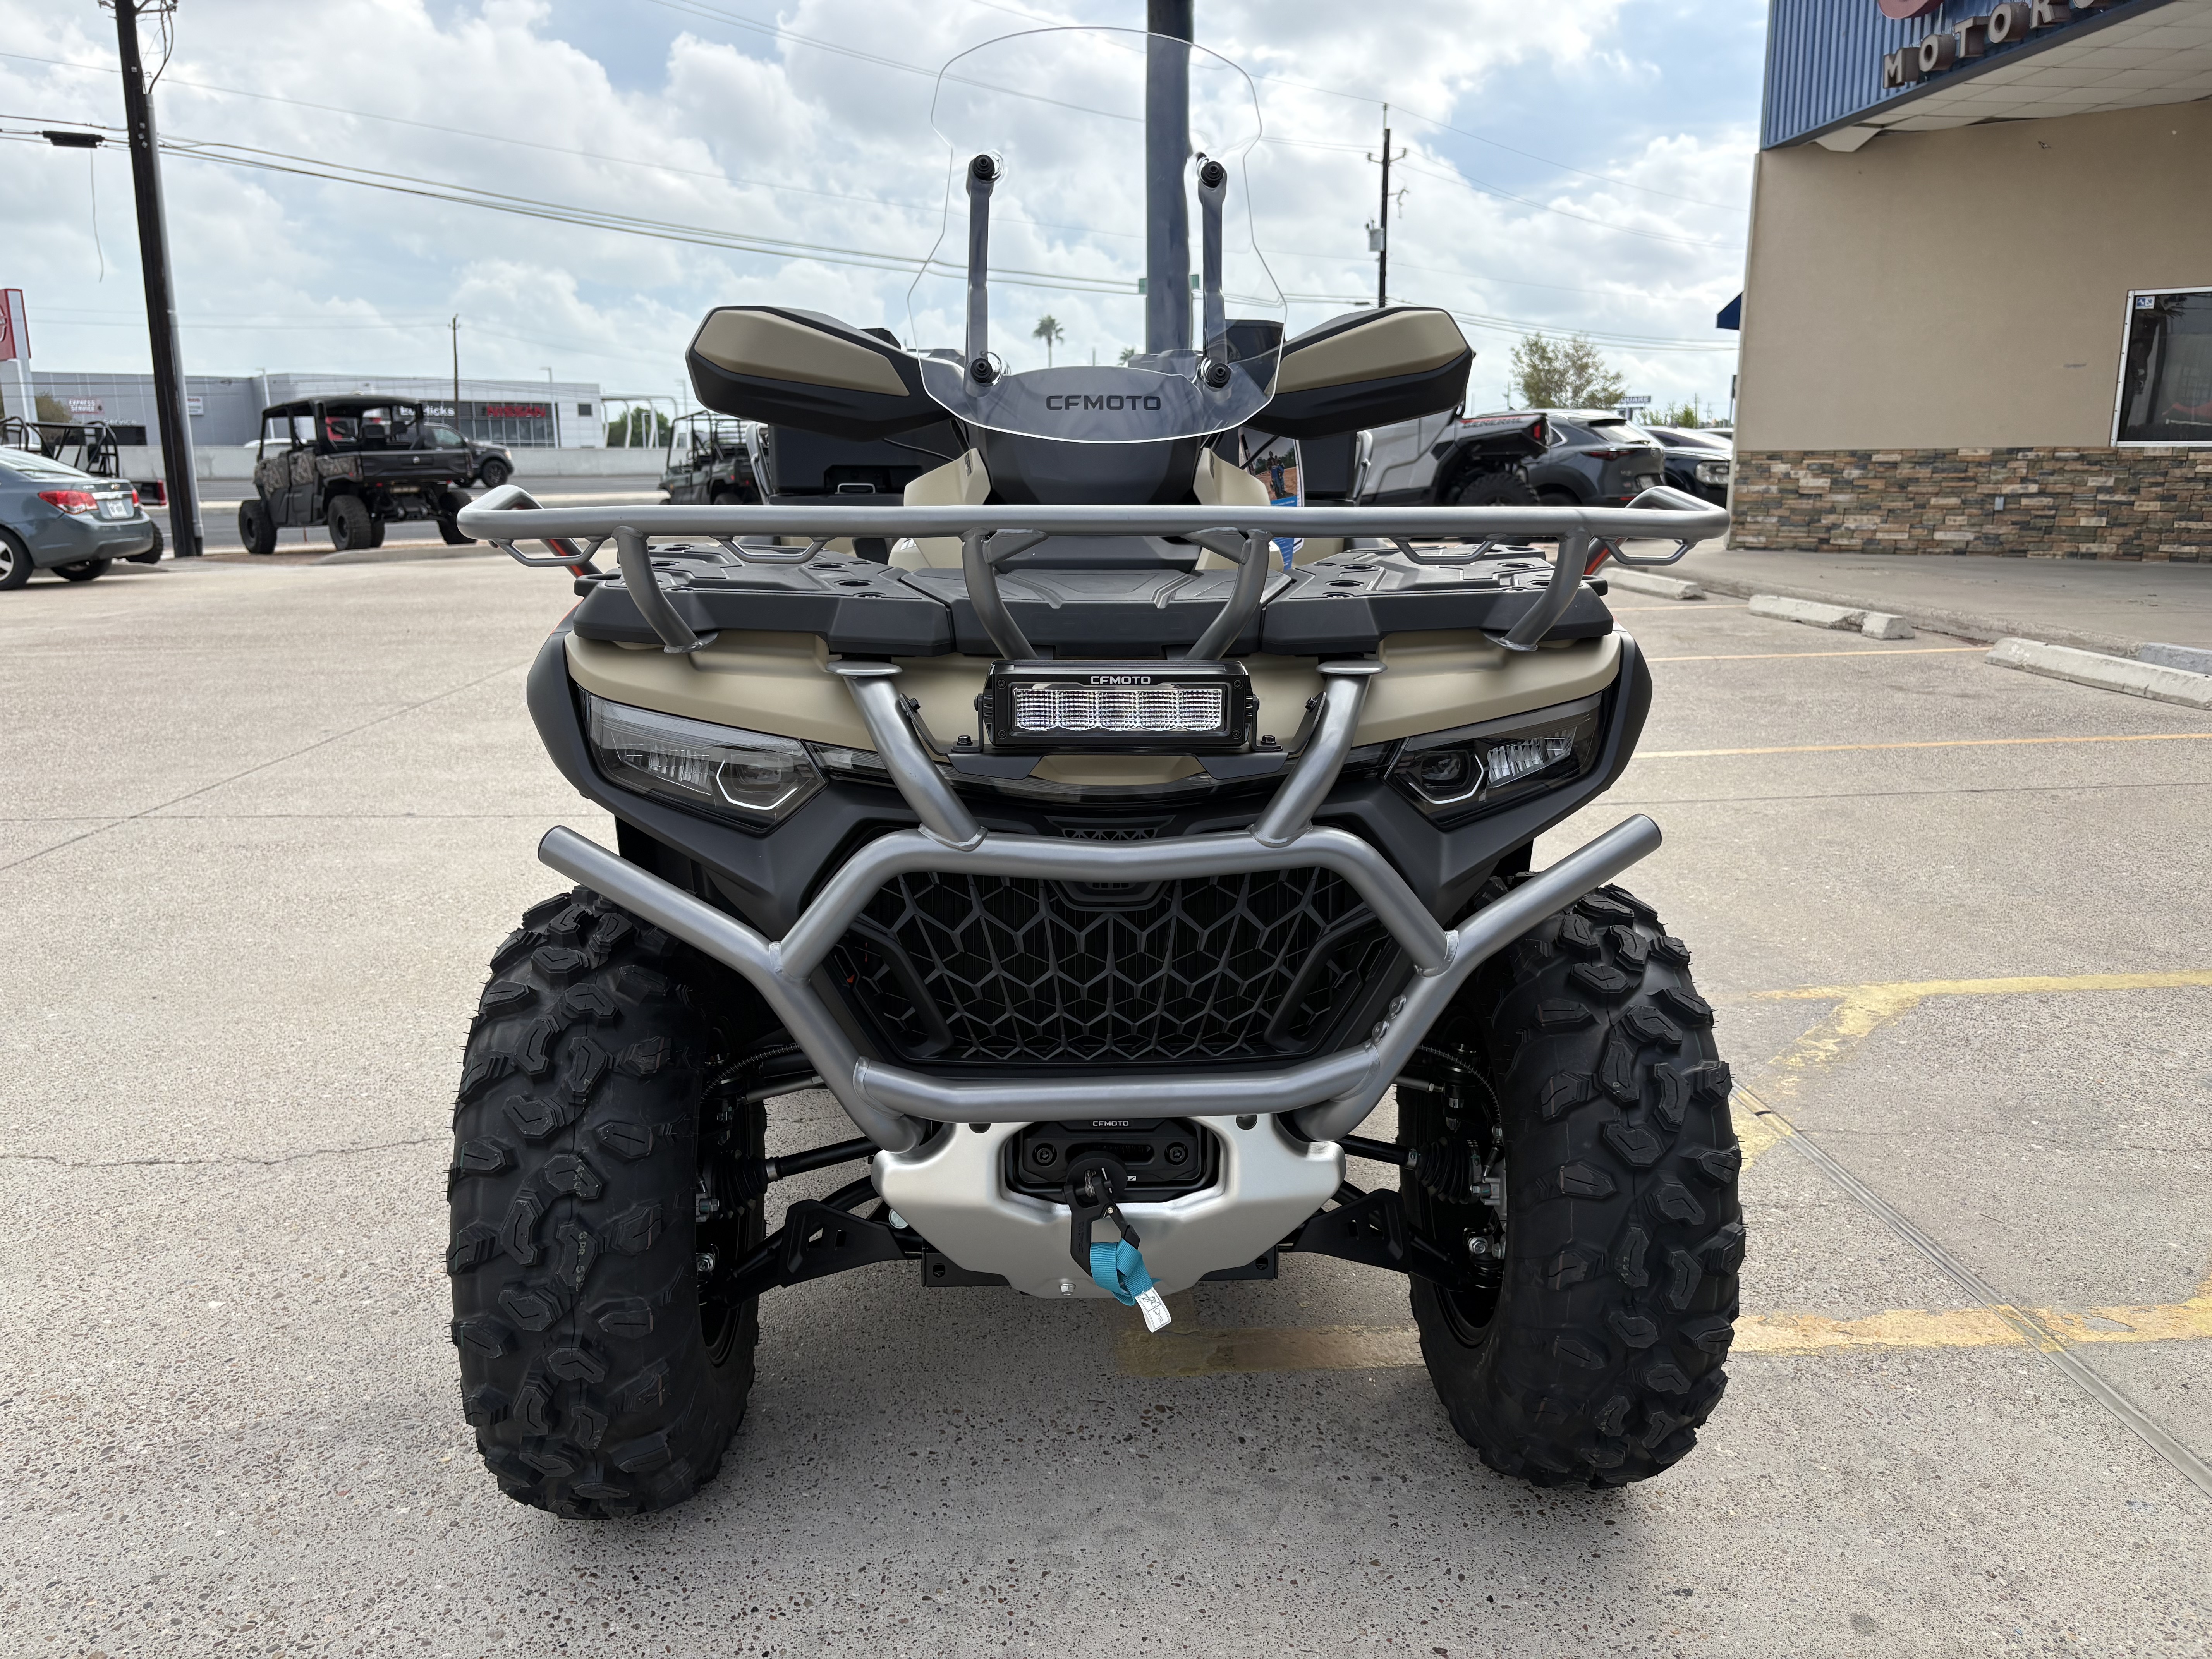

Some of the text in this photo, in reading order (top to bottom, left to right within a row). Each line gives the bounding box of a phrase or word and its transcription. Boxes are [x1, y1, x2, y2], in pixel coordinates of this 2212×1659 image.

[1883, 0, 2093, 89] MOTOR
[1046, 395, 1161, 410] CFMOTO
[487, 405, 546, 417] NISSAN
[1090, 676, 1151, 685] CFMOTO
